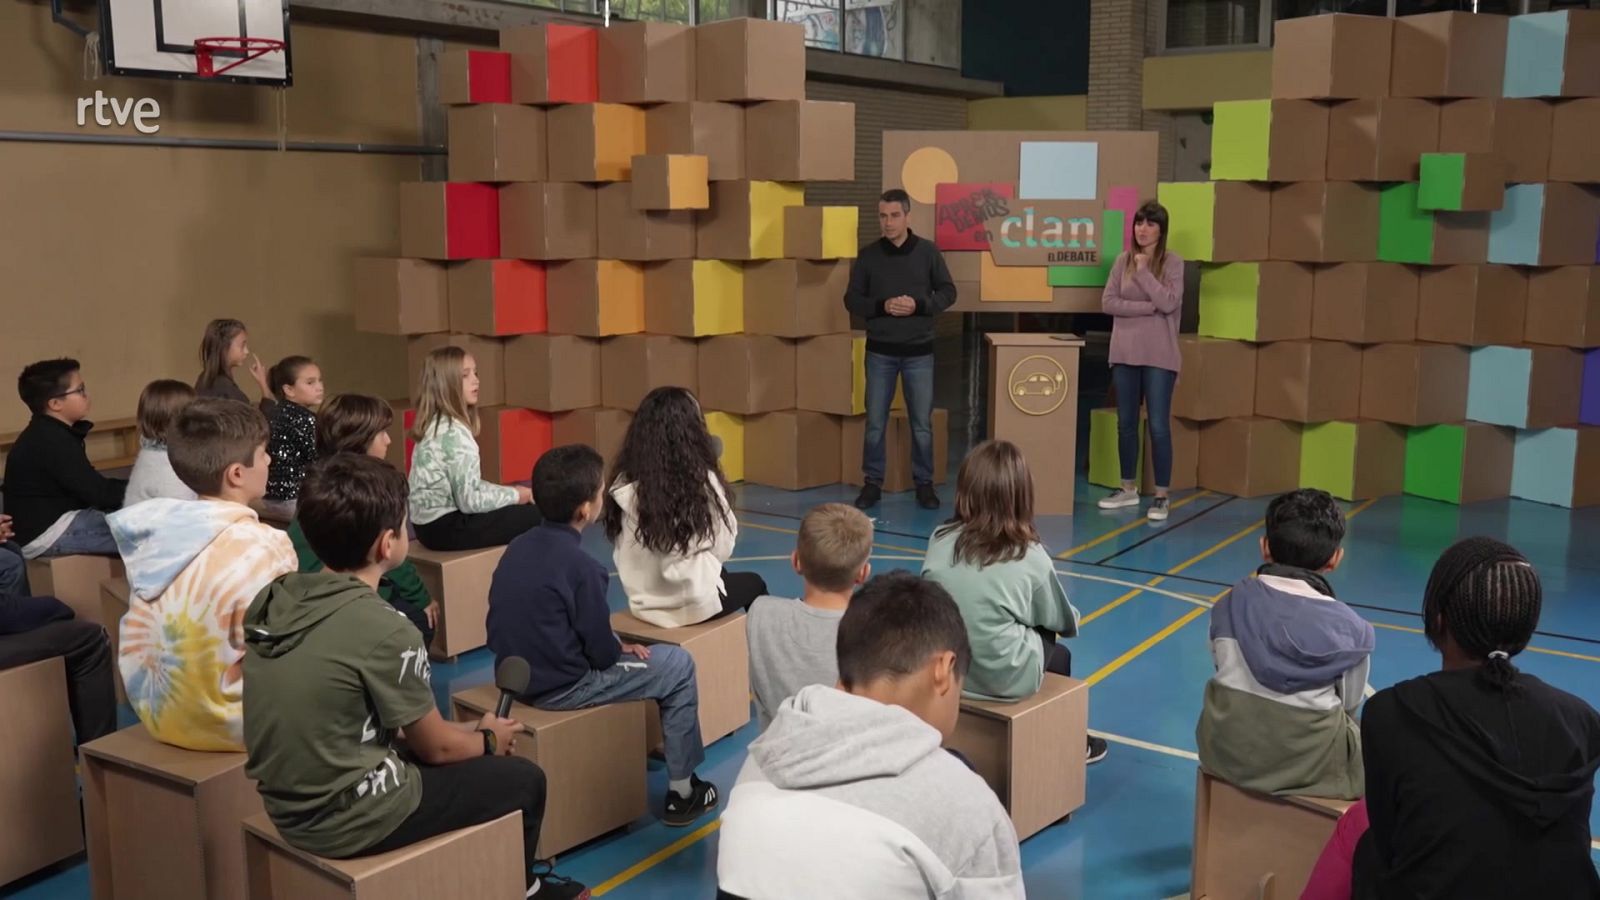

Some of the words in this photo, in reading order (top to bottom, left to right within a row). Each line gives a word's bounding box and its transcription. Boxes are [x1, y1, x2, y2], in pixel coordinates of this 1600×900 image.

[1000, 207, 1097, 248] clan
[974, 230, 993, 243] en
[1057, 251, 1097, 262] DEBATE
